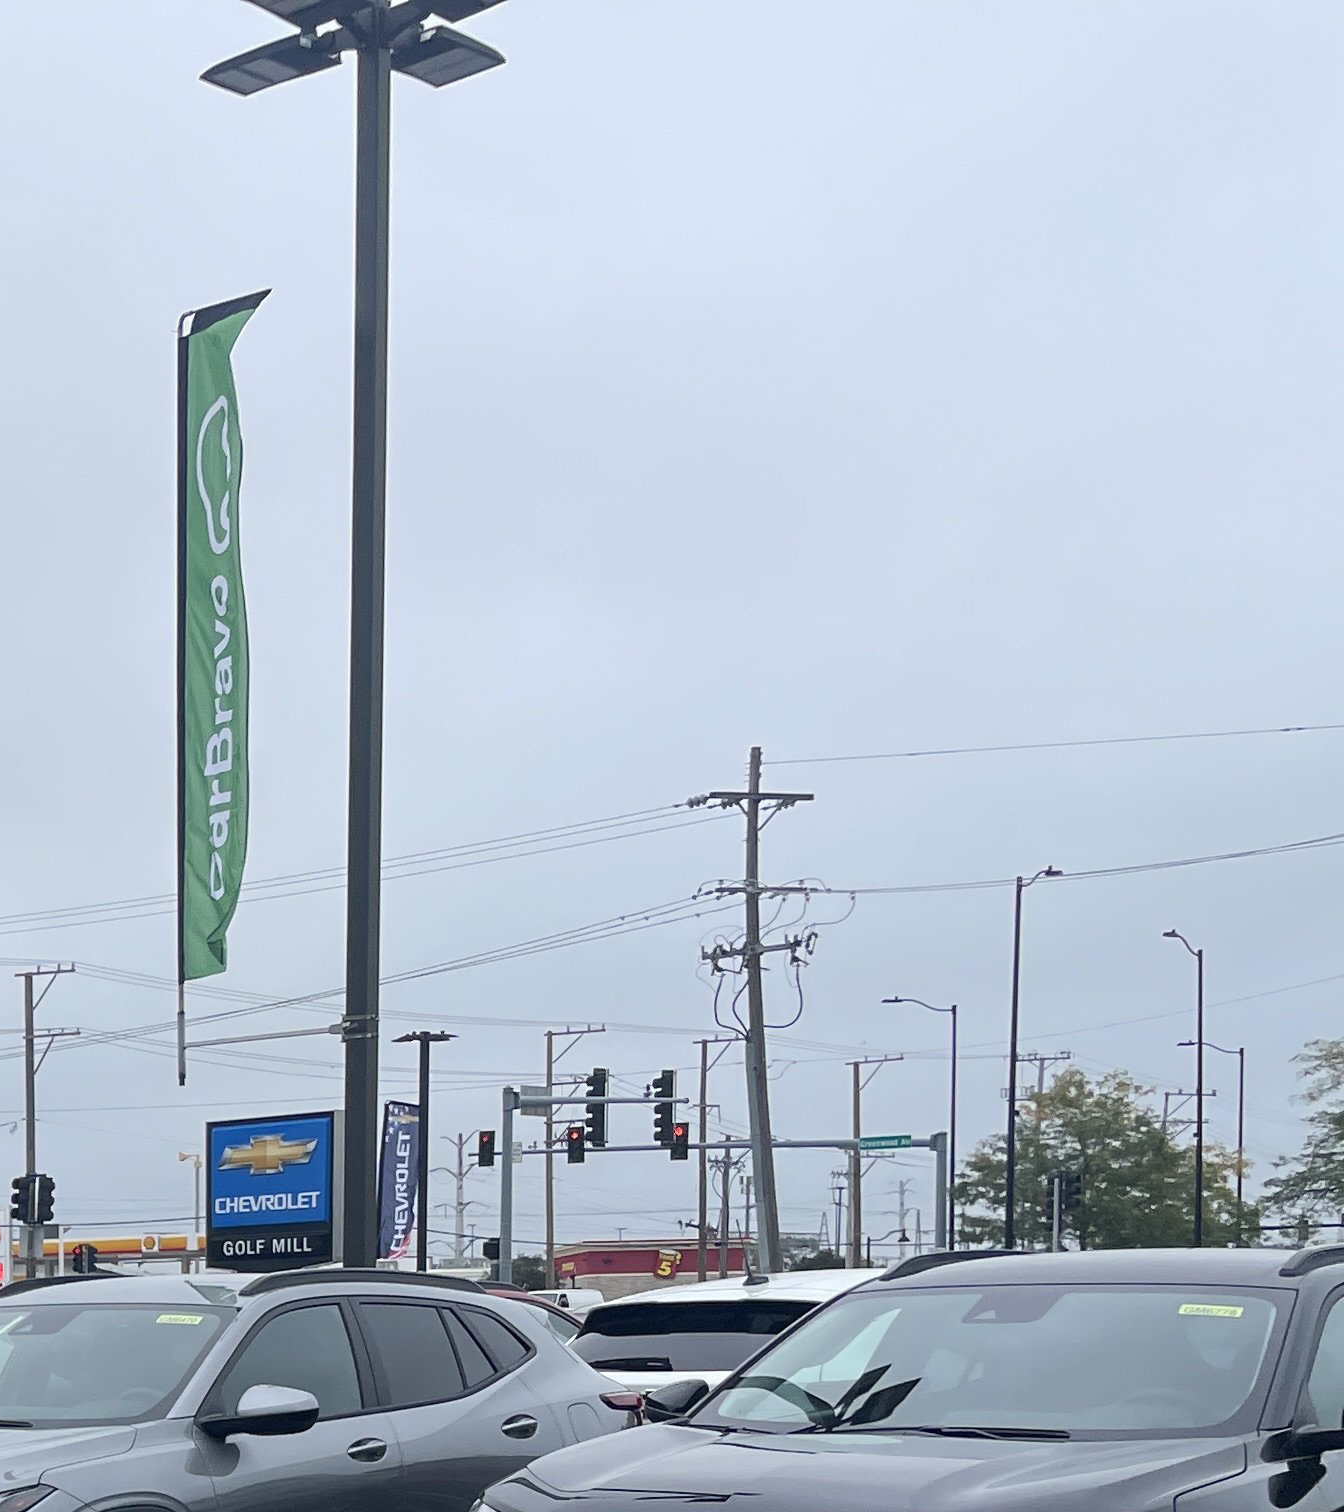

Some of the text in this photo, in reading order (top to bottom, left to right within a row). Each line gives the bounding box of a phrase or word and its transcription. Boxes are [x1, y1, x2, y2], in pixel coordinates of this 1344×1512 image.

[203, 574, 233, 901] carBravo
[214, 1191, 321, 1215] CHEVROLET
[389, 1131, 411, 1252] CHEVROLET
[223, 1237, 312, 1256] GOLF MILL
[657, 1261, 672, 1276] 5
